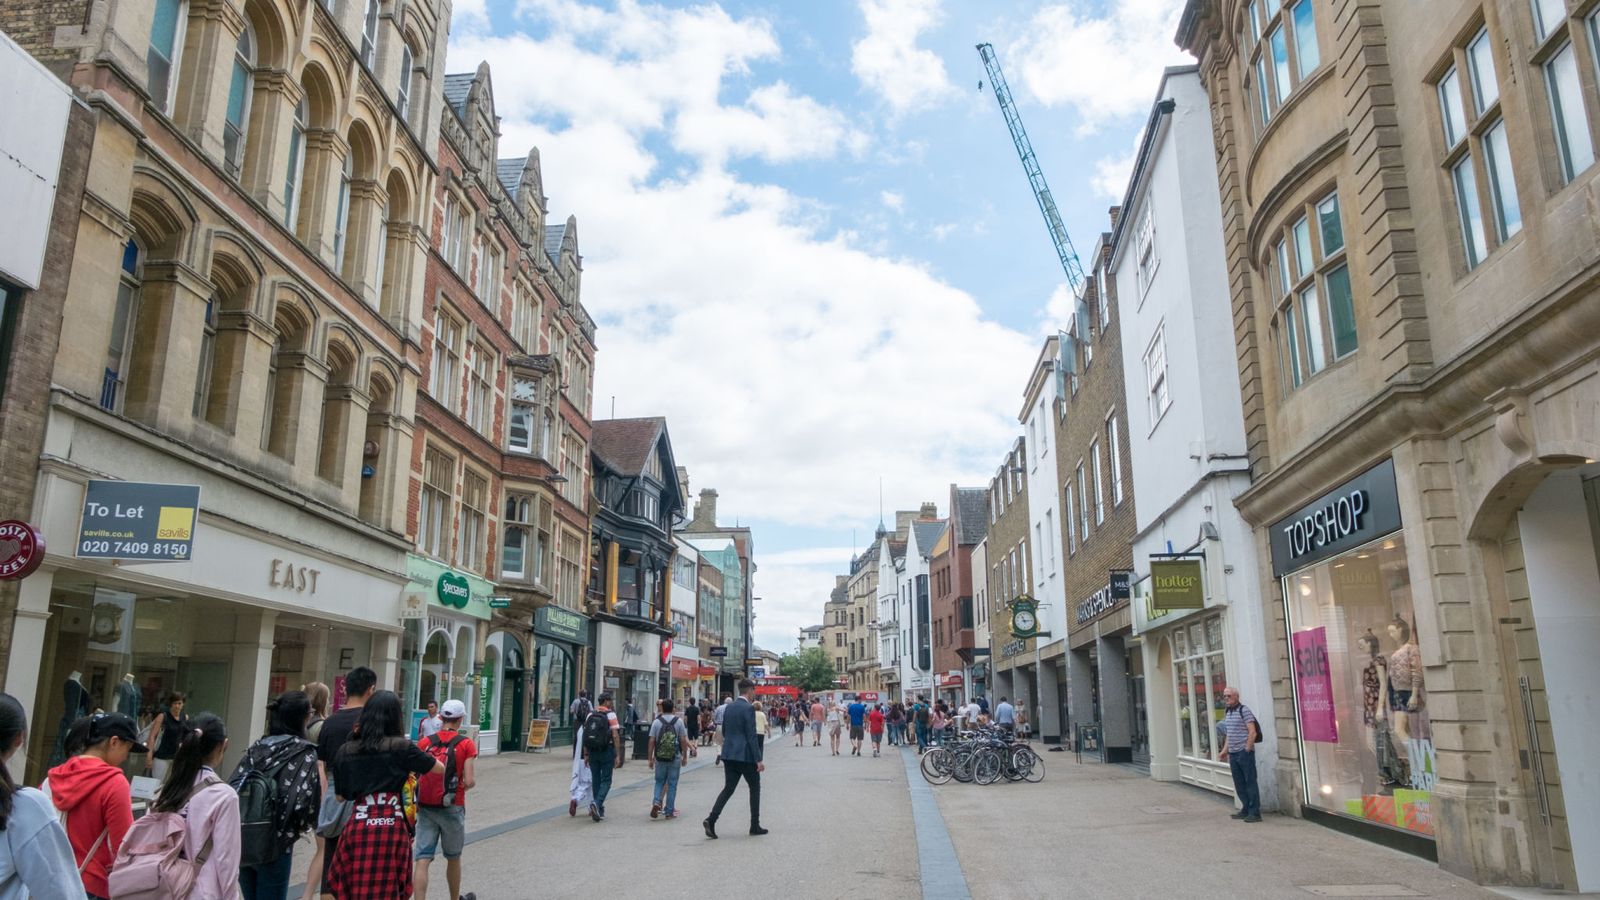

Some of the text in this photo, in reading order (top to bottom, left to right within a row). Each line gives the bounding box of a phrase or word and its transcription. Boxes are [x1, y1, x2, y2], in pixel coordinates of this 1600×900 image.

[87, 502, 145, 518] To Let
[159, 527, 189, 538] savills
[1284, 490, 1364, 559] TOPSHOP
[0, 525, 27, 541] OSTA
[83, 529, 135, 539] savills.co.uk
[82, 540, 188, 555] 020 7409 8150
[270, 559, 321, 594] EAST
[1155, 575, 1198, 587] hotter
[442, 579, 468, 598] Specsavers
[1296, 636, 1327, 678] sale
[366, 818, 396, 826] POPEYES
